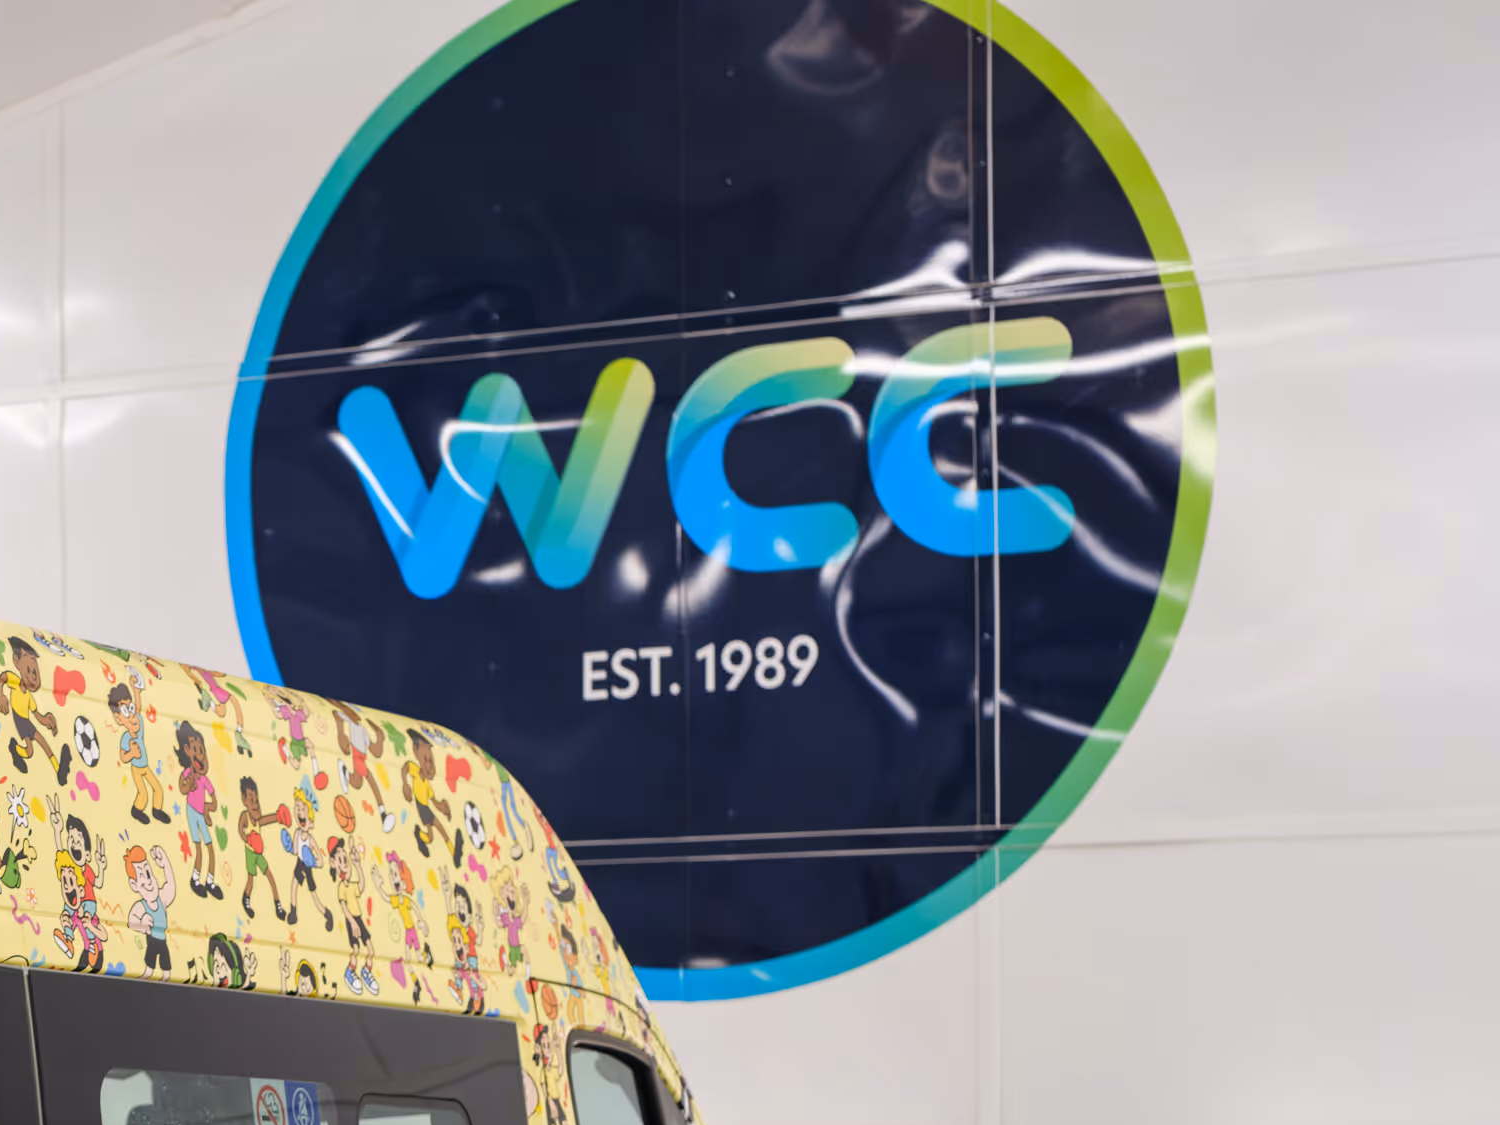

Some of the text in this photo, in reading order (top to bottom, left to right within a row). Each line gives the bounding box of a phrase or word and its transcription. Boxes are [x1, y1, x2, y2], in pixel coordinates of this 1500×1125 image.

[337, 316, 1076, 599] WCC
[582, 634, 819, 701] EST. 1989
